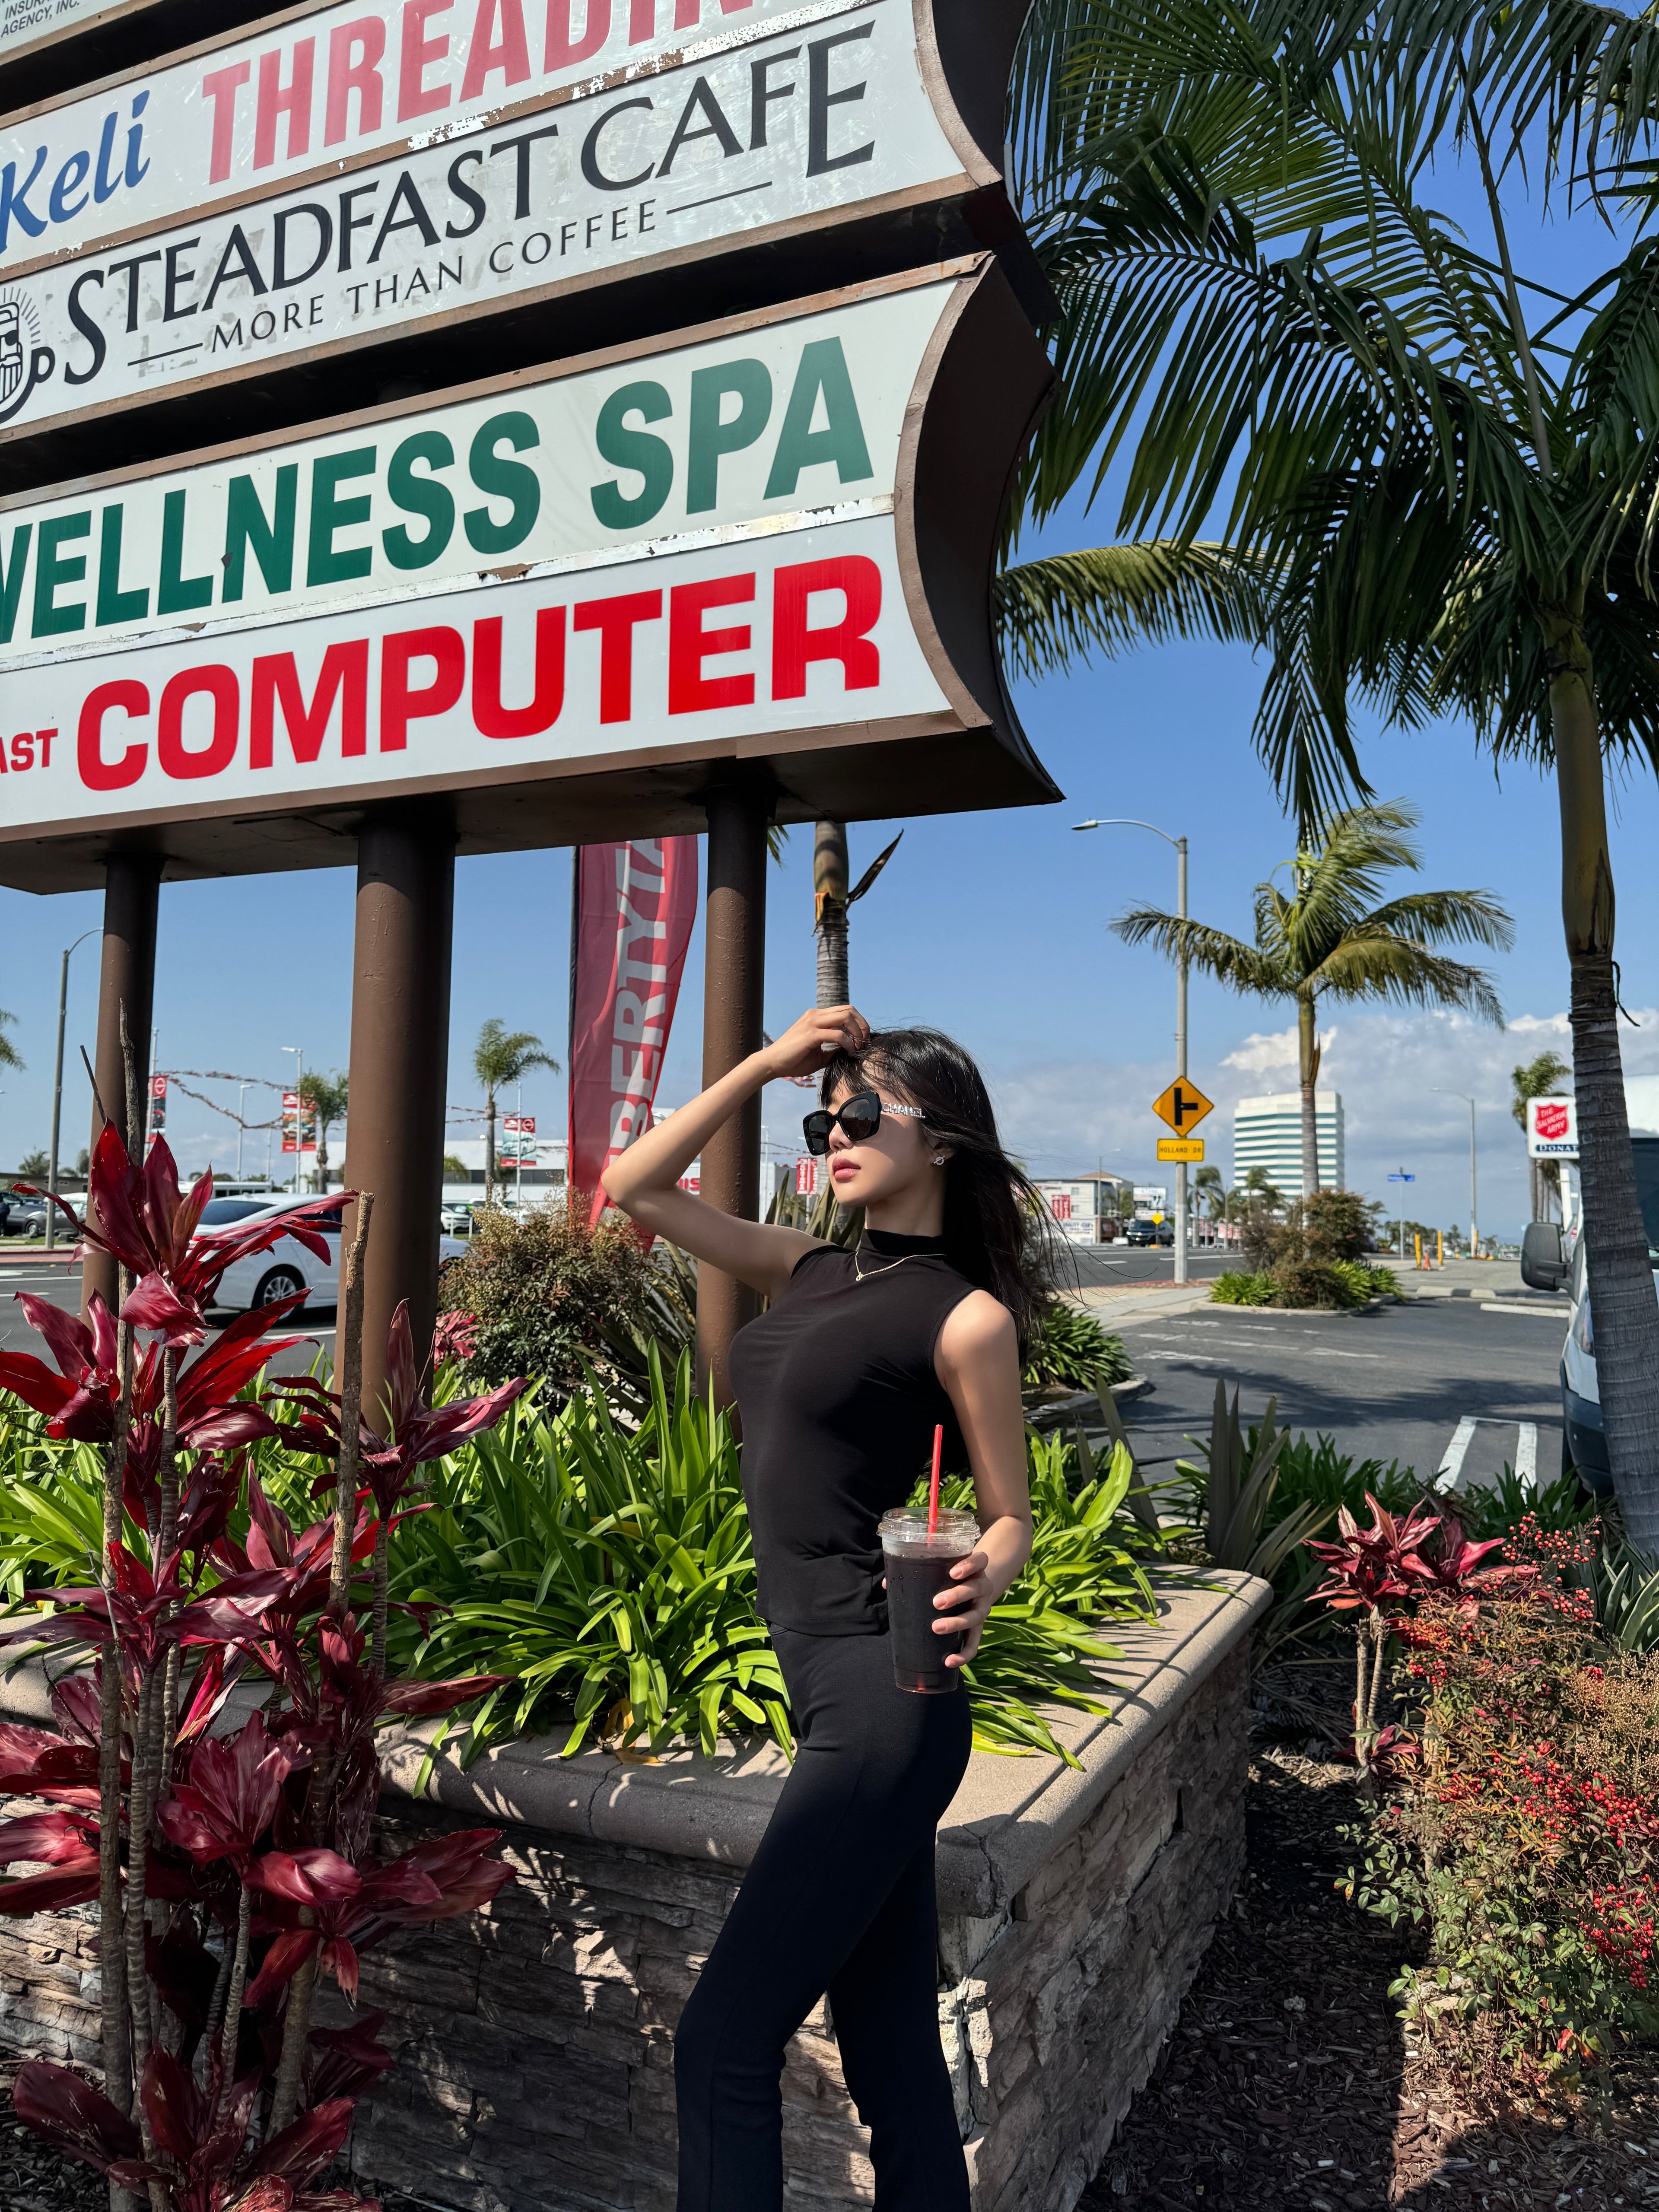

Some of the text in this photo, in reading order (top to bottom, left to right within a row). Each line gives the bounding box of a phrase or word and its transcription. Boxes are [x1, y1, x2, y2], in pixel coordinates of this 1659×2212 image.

[1, 0, 79, 38] AGENCY, INC.
[0, 0, 753, 254] Keli THREAD
[64, 20, 875, 385] STEADFAST CAFE
[211, 199, 658, 353] MORE THAN COFFEE
[590, 336, 874, 529] SPA
[77, 555, 882, 791] COMPUTER
[609, 891, 667, 1166] BERTY
[881, 1103, 926, 1119] CHANEL
